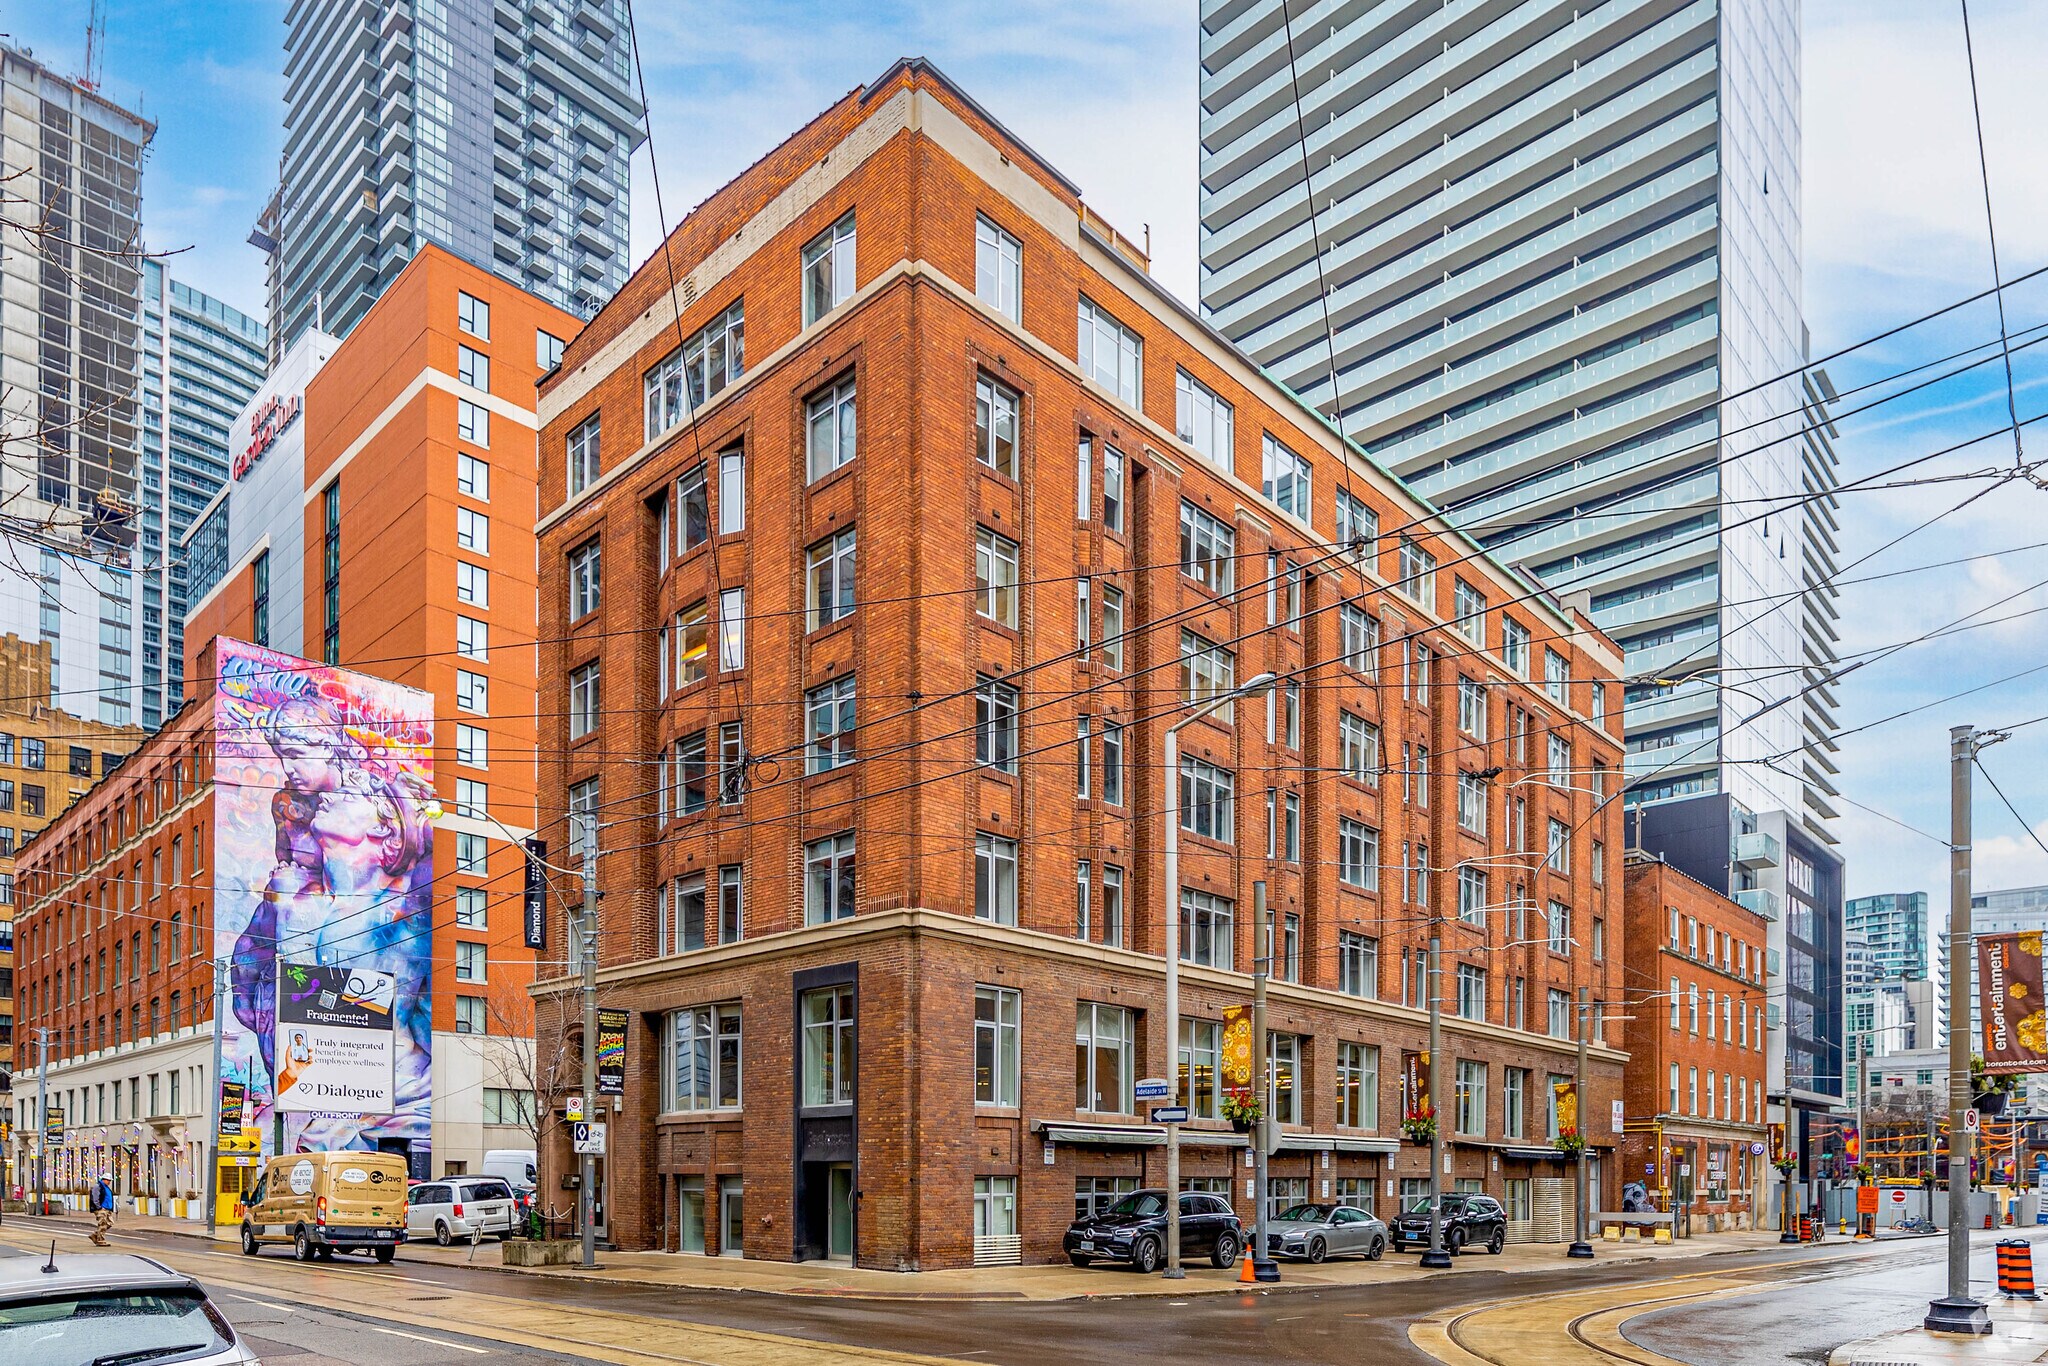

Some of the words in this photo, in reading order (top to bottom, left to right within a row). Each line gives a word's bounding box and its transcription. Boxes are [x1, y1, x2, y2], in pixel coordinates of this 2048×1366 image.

[233, 422, 276, 481] Garden
[275, 393, 301, 435] Inn
[530, 901, 541, 943] Diamond
[1988, 942, 2007, 1051] entertainment
[306, 1009, 369, 1026] Fragmented
[314, 1038, 338, 1048] Truly
[340, 1038, 384, 1050] integrated
[314, 1048, 346, 1057] benefits
[347, 1050, 359, 1058] for
[314, 1057, 351, 1066] employee
[353, 1058, 385, 1067] wellness
[1986, 1059, 2047, 1068] torontoed.com
[317, 1082, 384, 1101] Dialogue
[310, 1110, 361, 1119] OUTFRONT
